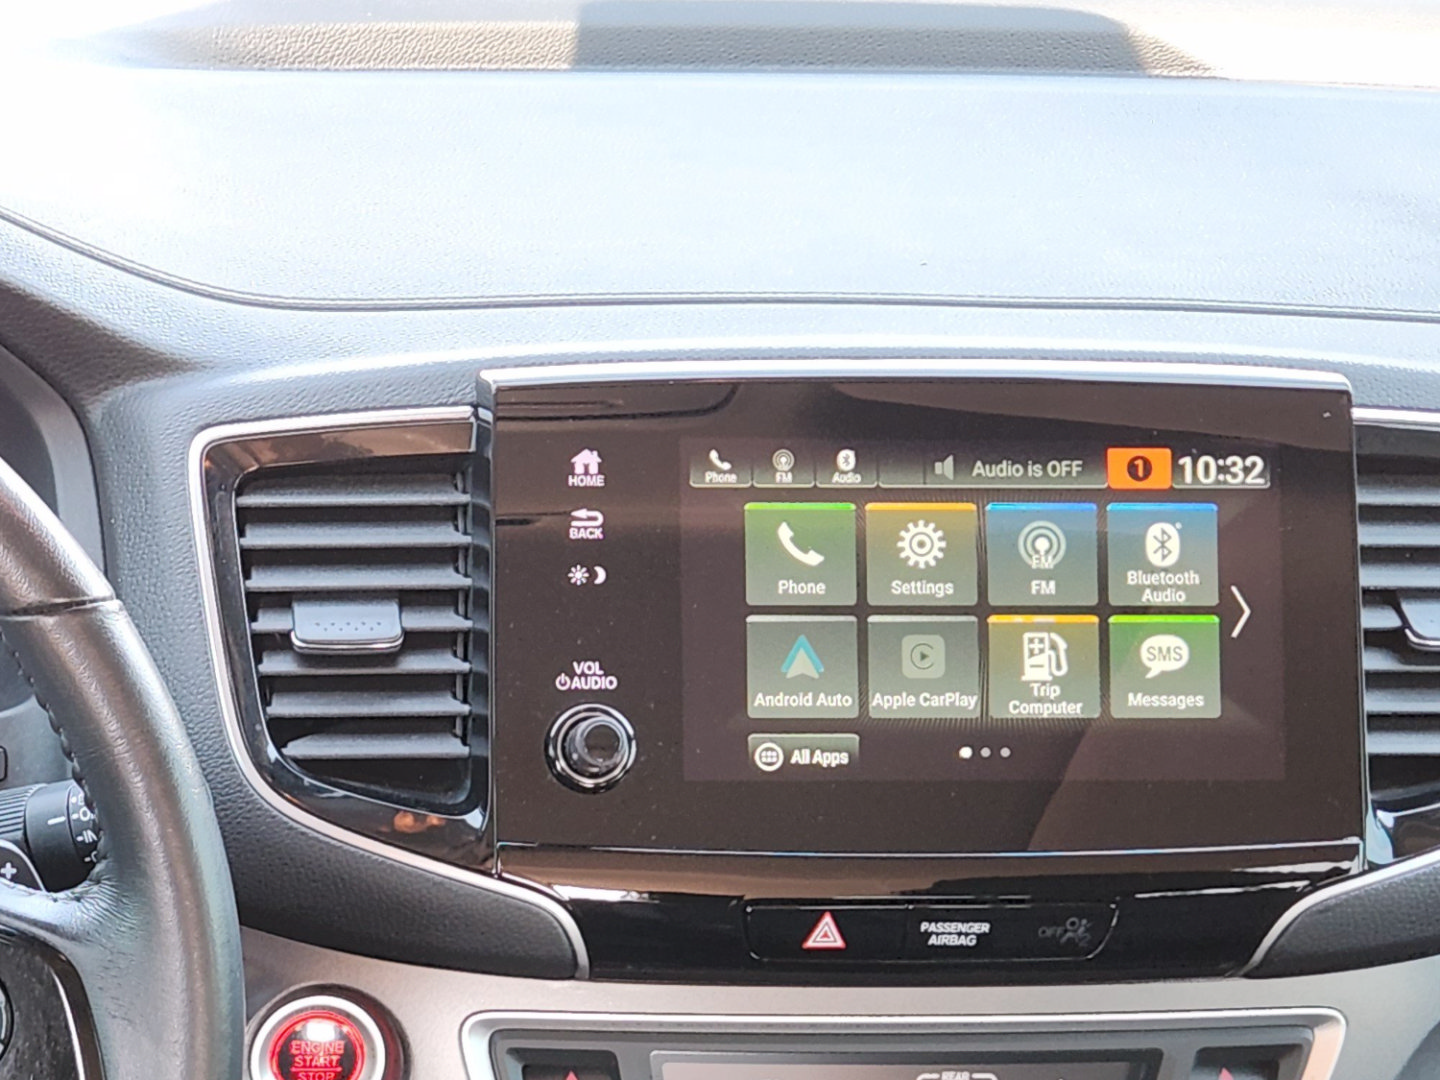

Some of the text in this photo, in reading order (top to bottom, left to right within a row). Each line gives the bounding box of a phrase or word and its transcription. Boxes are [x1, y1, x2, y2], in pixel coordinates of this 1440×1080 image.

[972, 459, 1083, 478] Audio is OFF
[1177, 455, 1266, 485] 10:32
[568, 475, 605, 487] HOME
[705, 471, 737, 484] Phone
[775, 471, 793, 483] FM
[832, 471, 861, 484] Audio
[569, 527, 604, 540] BACK
[1127, 570, 1200, 585] Bluetooth
[777, 580, 826, 595] Phone
[891, 580, 954, 597] Settings
[1031, 580, 1056, 595] FM
[1142, 588, 1186, 603] Audio
[1146, 646, 1183, 662] SMS
[573, 661, 604, 675] VOL
[571, 676, 618, 690] AUDIO
[1029, 683, 1061, 699] Trip
[753, 692, 852, 707] Android Auto
[871, 692, 978, 710] Apple CarPlay
[1128, 692, 1205, 710] Messages
[1008, 700, 1083, 718] Computer
[790, 749, 849, 767] All Apps
[920, 921, 991, 934] PASSENGER
[928, 934, 977, 946] AIRBAG
[290, 1040, 344, 1055] ENGINE
[294, 1055, 340, 1067] START
